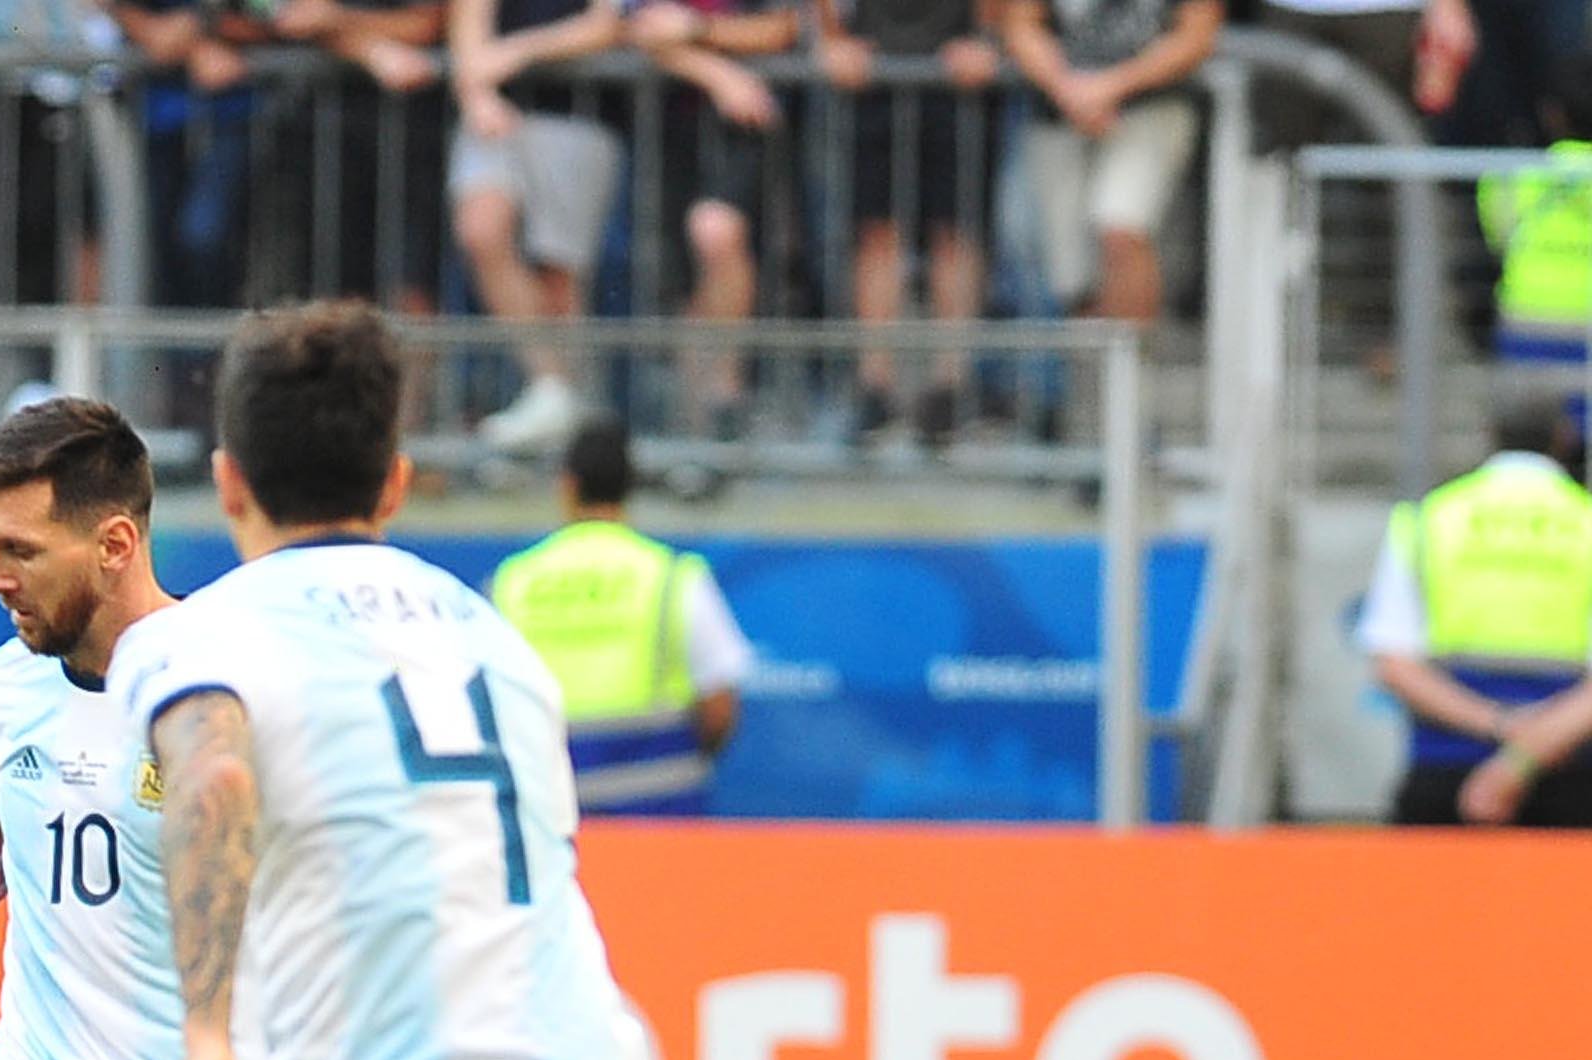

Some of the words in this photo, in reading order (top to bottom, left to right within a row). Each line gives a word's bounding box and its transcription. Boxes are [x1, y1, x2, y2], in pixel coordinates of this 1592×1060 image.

[304, 583, 478, 626] SARAV
[379, 666, 531, 905] 4
[45, 811, 122, 907] 10
